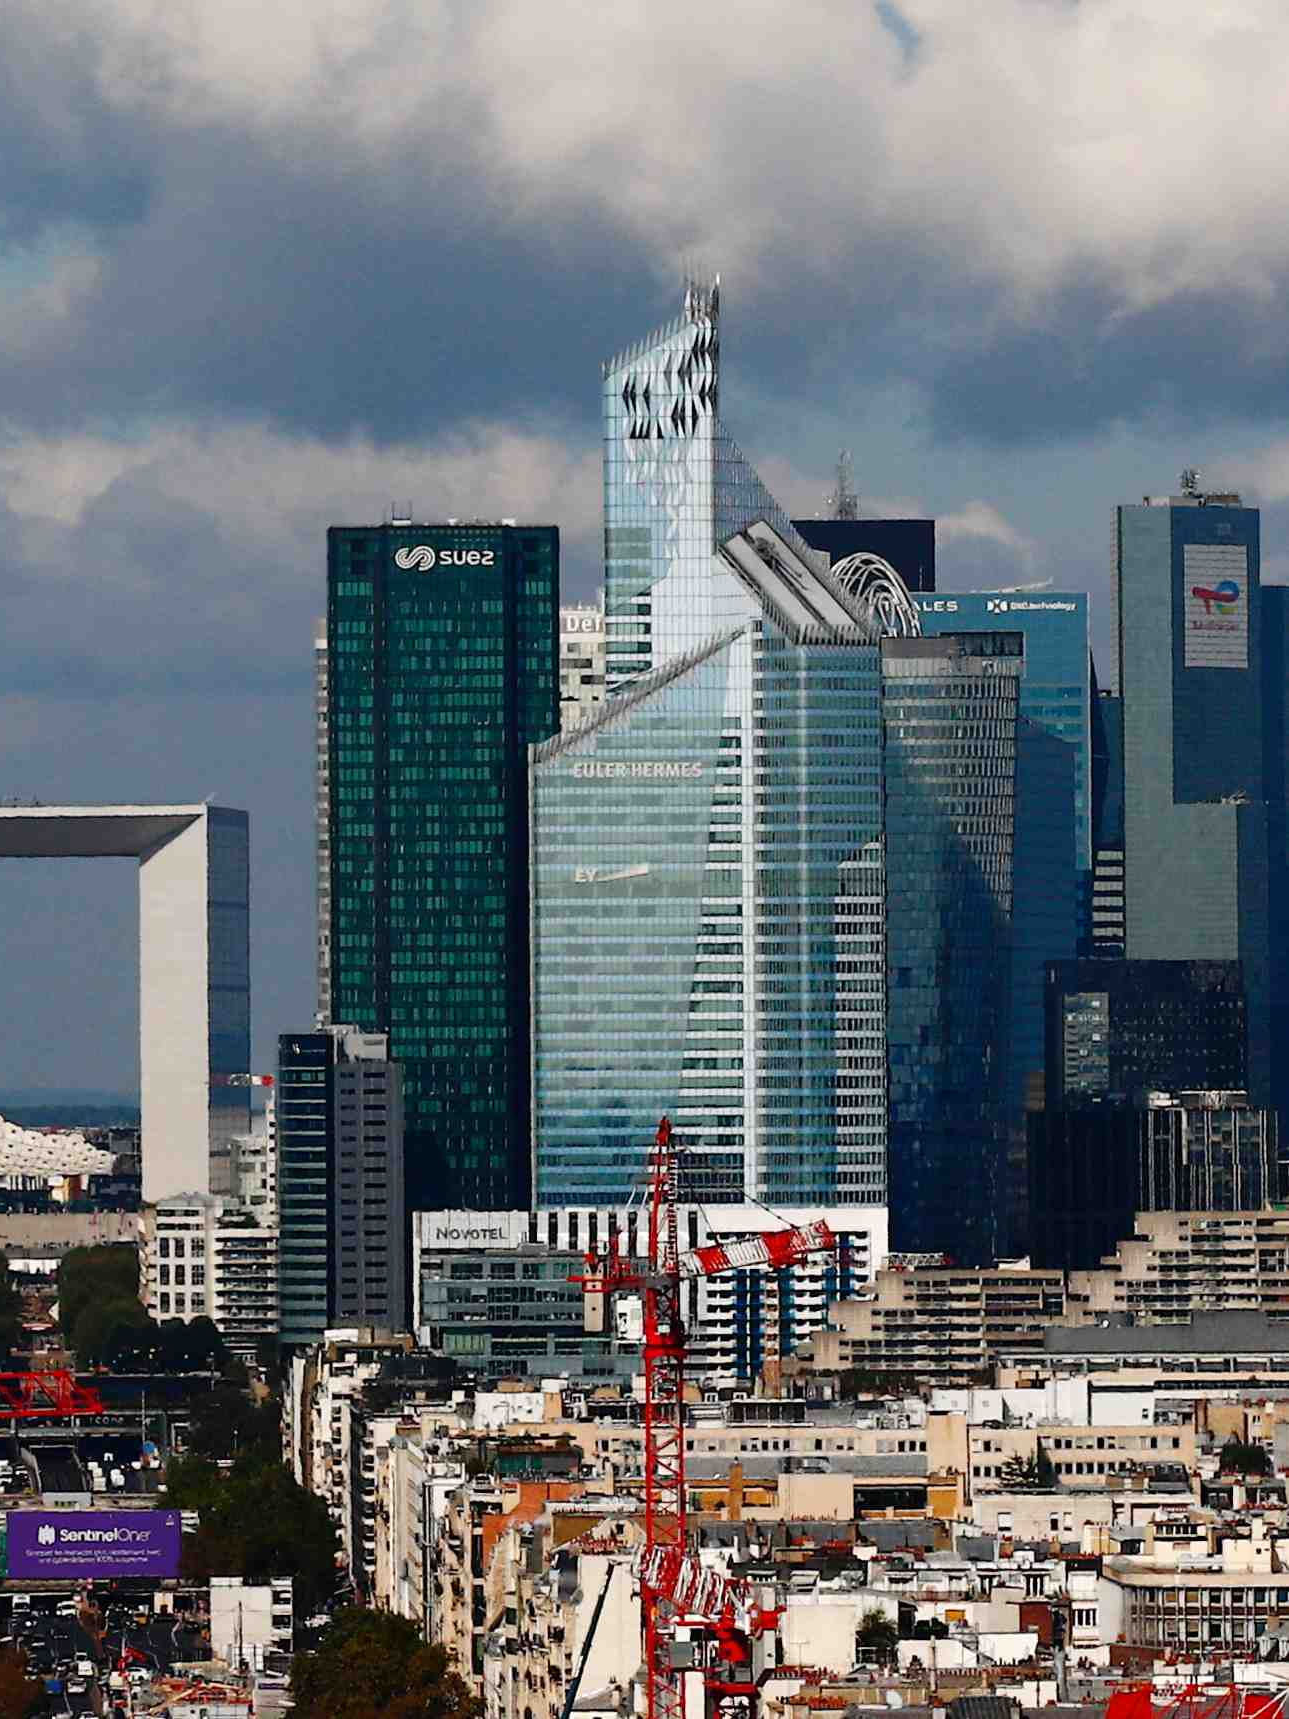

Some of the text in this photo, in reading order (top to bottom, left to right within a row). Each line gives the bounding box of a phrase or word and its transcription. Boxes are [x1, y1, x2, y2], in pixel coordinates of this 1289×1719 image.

[573, 761, 703, 778] EULER HERMES
[436, 1227, 509, 1240] NOVOTEL
